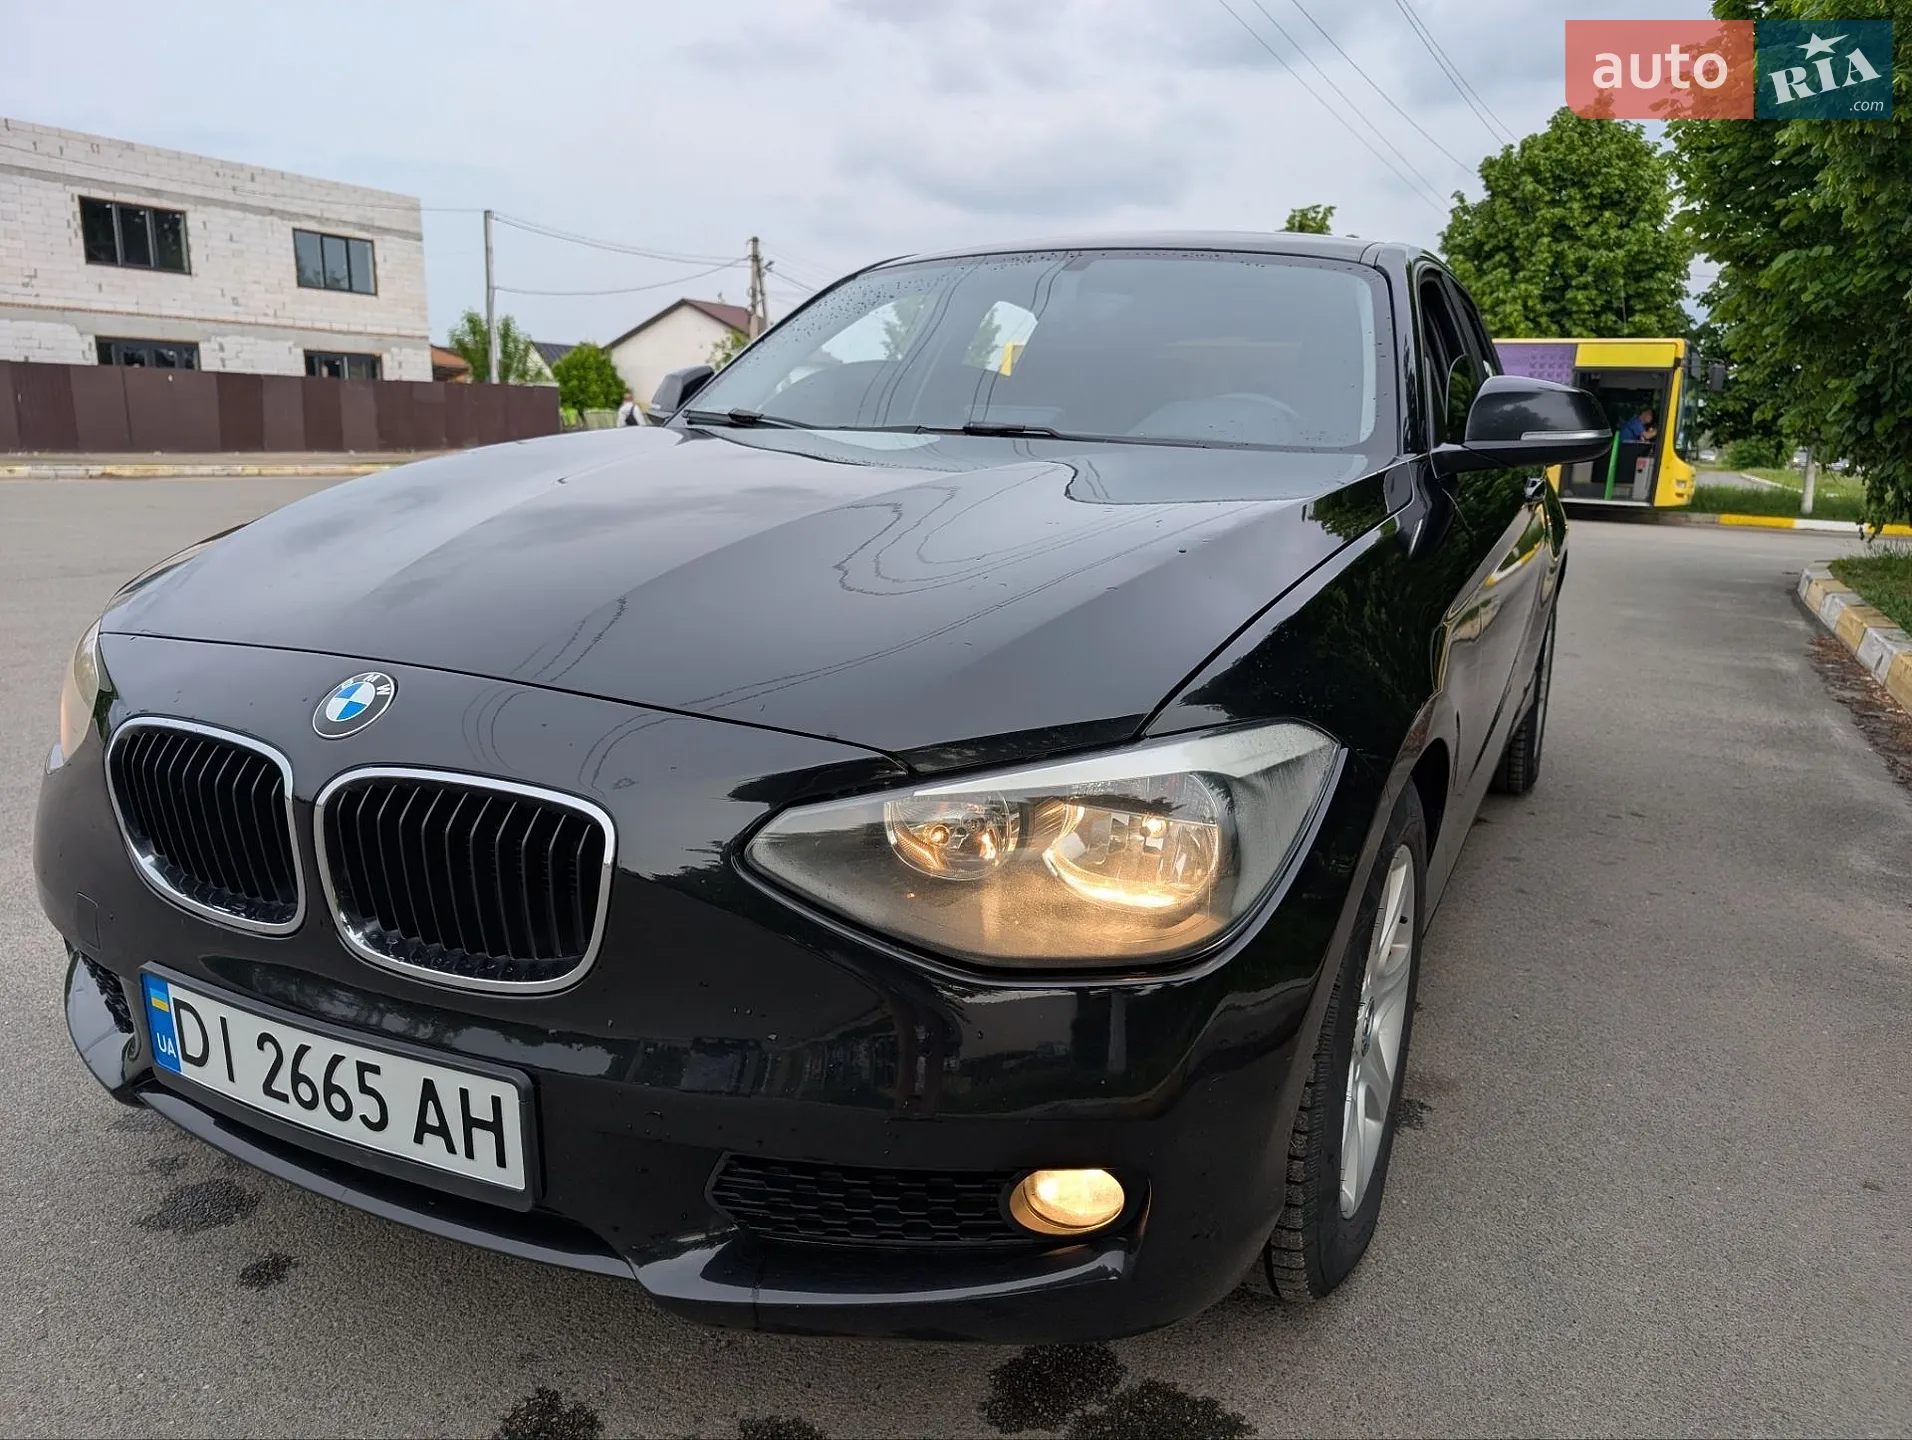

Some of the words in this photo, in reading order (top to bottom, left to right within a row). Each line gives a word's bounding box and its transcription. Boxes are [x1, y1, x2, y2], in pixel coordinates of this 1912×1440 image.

[156, 1032, 178, 1059] UA
[172, 997, 236, 1083] DI
[256, 1031, 389, 1132] 2665
[412, 1077, 508, 1169] AH
